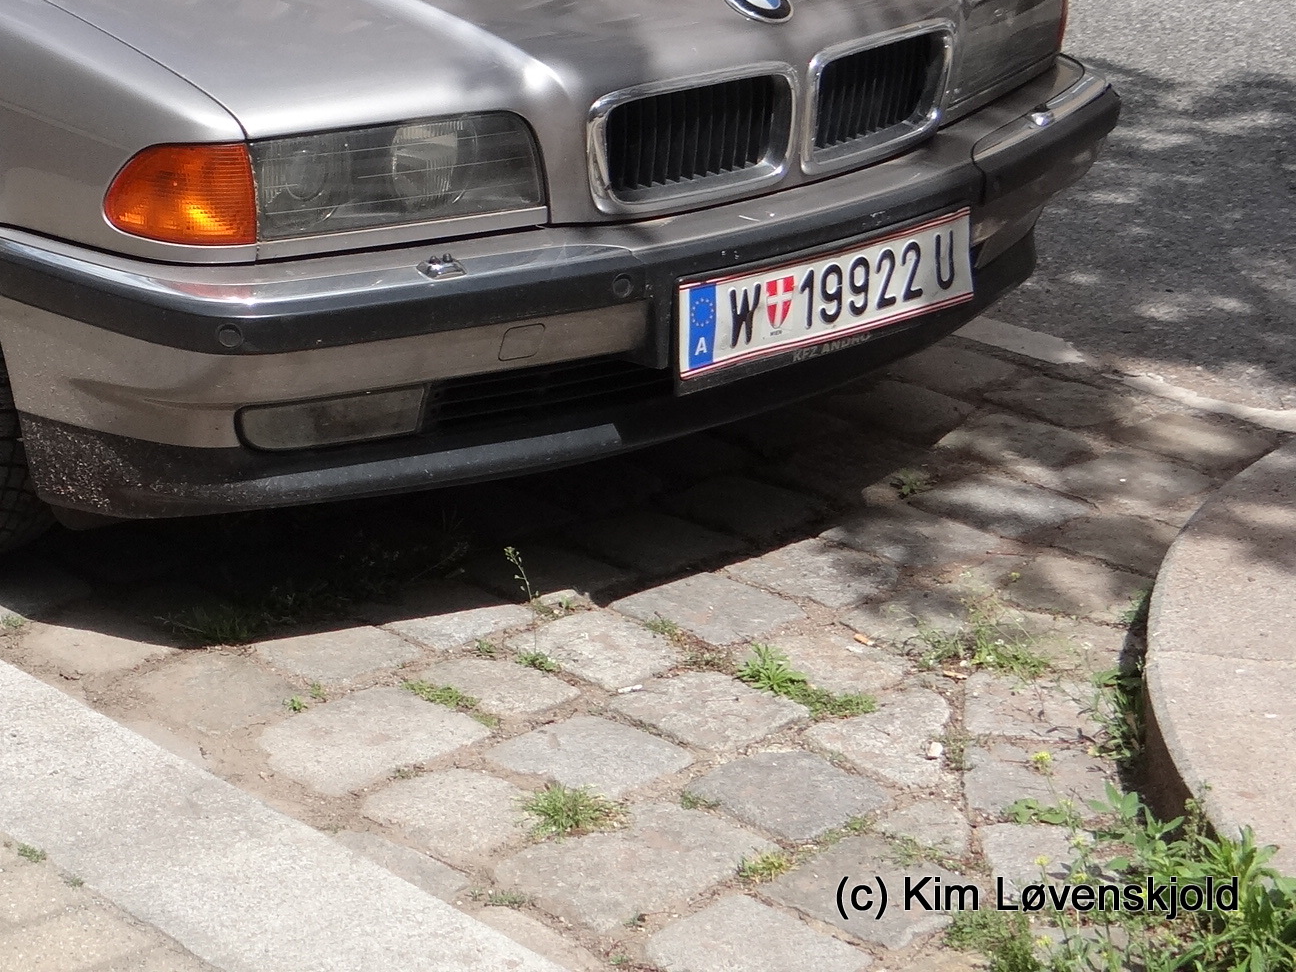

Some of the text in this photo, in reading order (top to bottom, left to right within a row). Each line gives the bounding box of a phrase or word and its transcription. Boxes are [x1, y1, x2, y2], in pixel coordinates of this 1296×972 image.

[729, 229, 955, 348] W 19922 U
[694, 336, 708, 357] A
